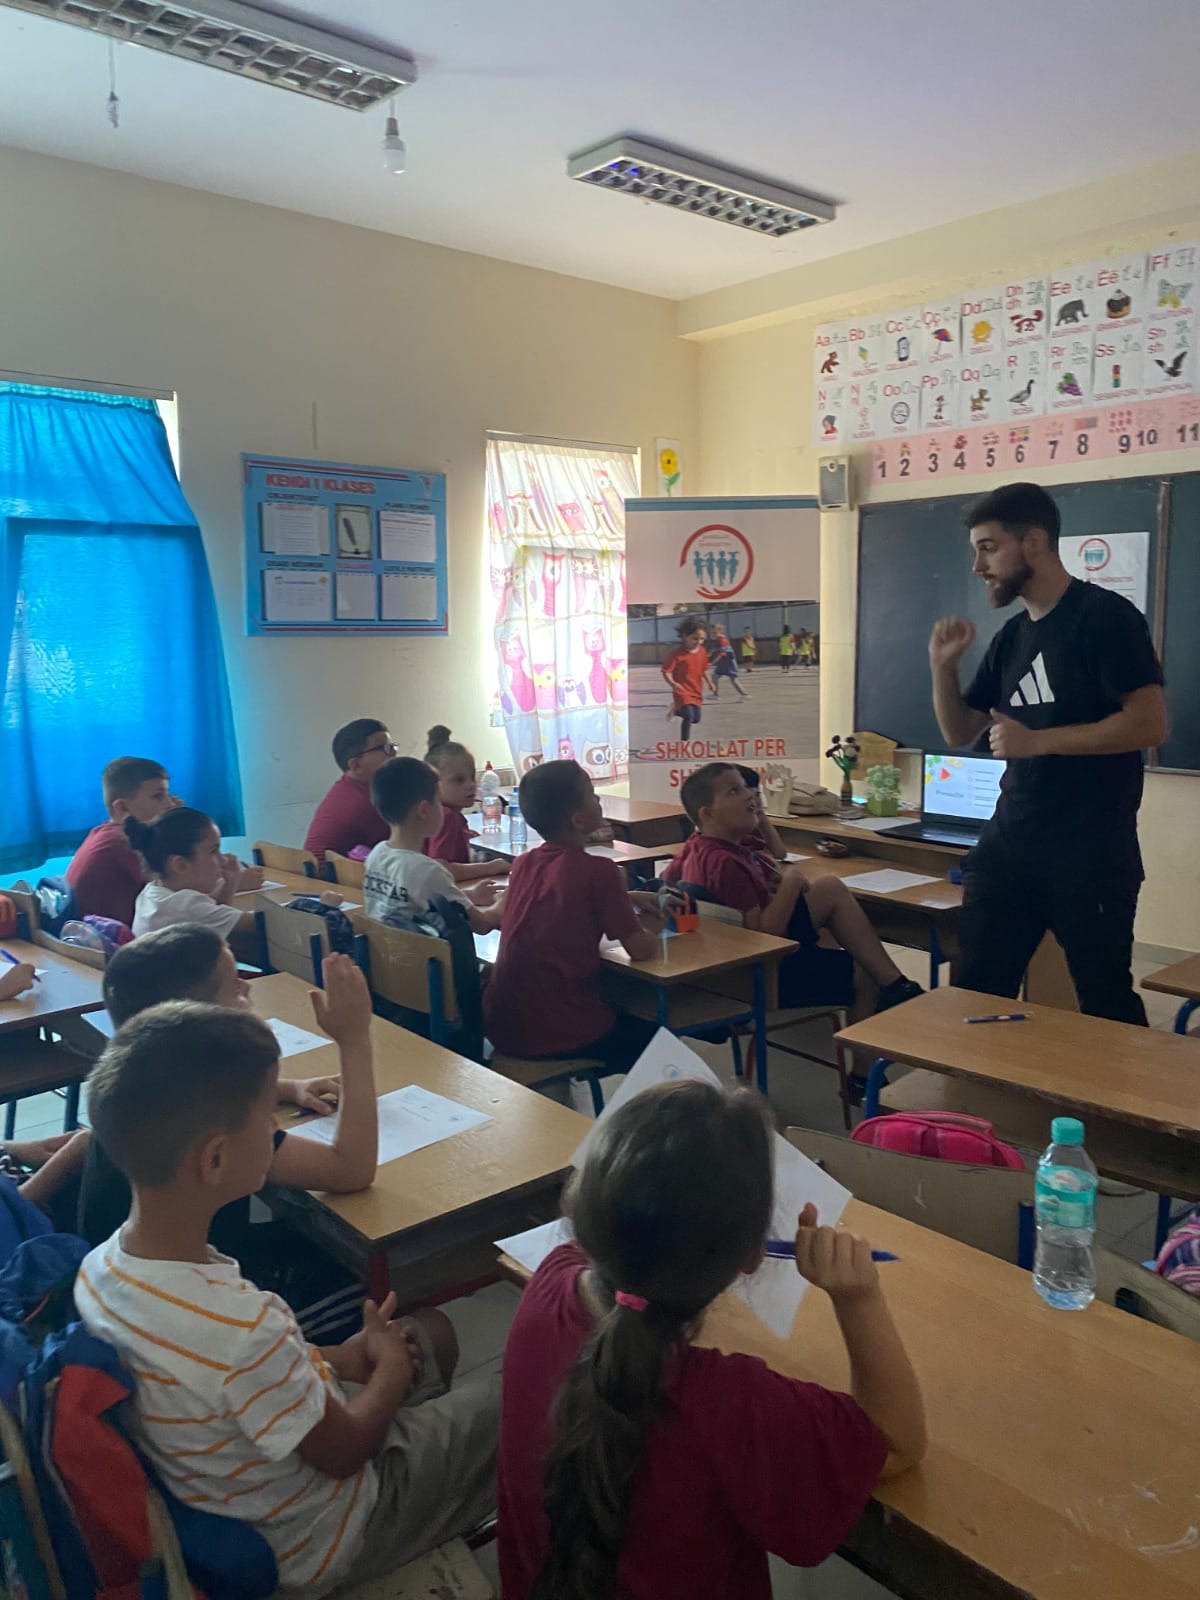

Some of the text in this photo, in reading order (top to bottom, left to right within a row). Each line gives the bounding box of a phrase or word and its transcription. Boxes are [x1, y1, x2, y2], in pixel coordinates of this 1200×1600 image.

[848, 327, 866, 342] Bb
[885, 320, 904, 334] Cc
[816, 335, 831, 346] Aa
[1095, 343, 1117, 358] Ss
[921, 375, 939, 389] Pp
[877, 461, 887, 478] 1
[899, 458, 910, 476] 2
[928, 453, 939, 473] 3
[954, 451, 967, 470] 4
[985, 448, 996, 468] 5
[1015, 444, 1025, 463] 6
[1048, 440, 1059, 460] 7
[1076, 433, 1089, 455] 8
[1118, 434, 1132, 454] 9
[1136, 428, 1158, 446] 10
[655, 739, 749, 760] SHKOLLAT
